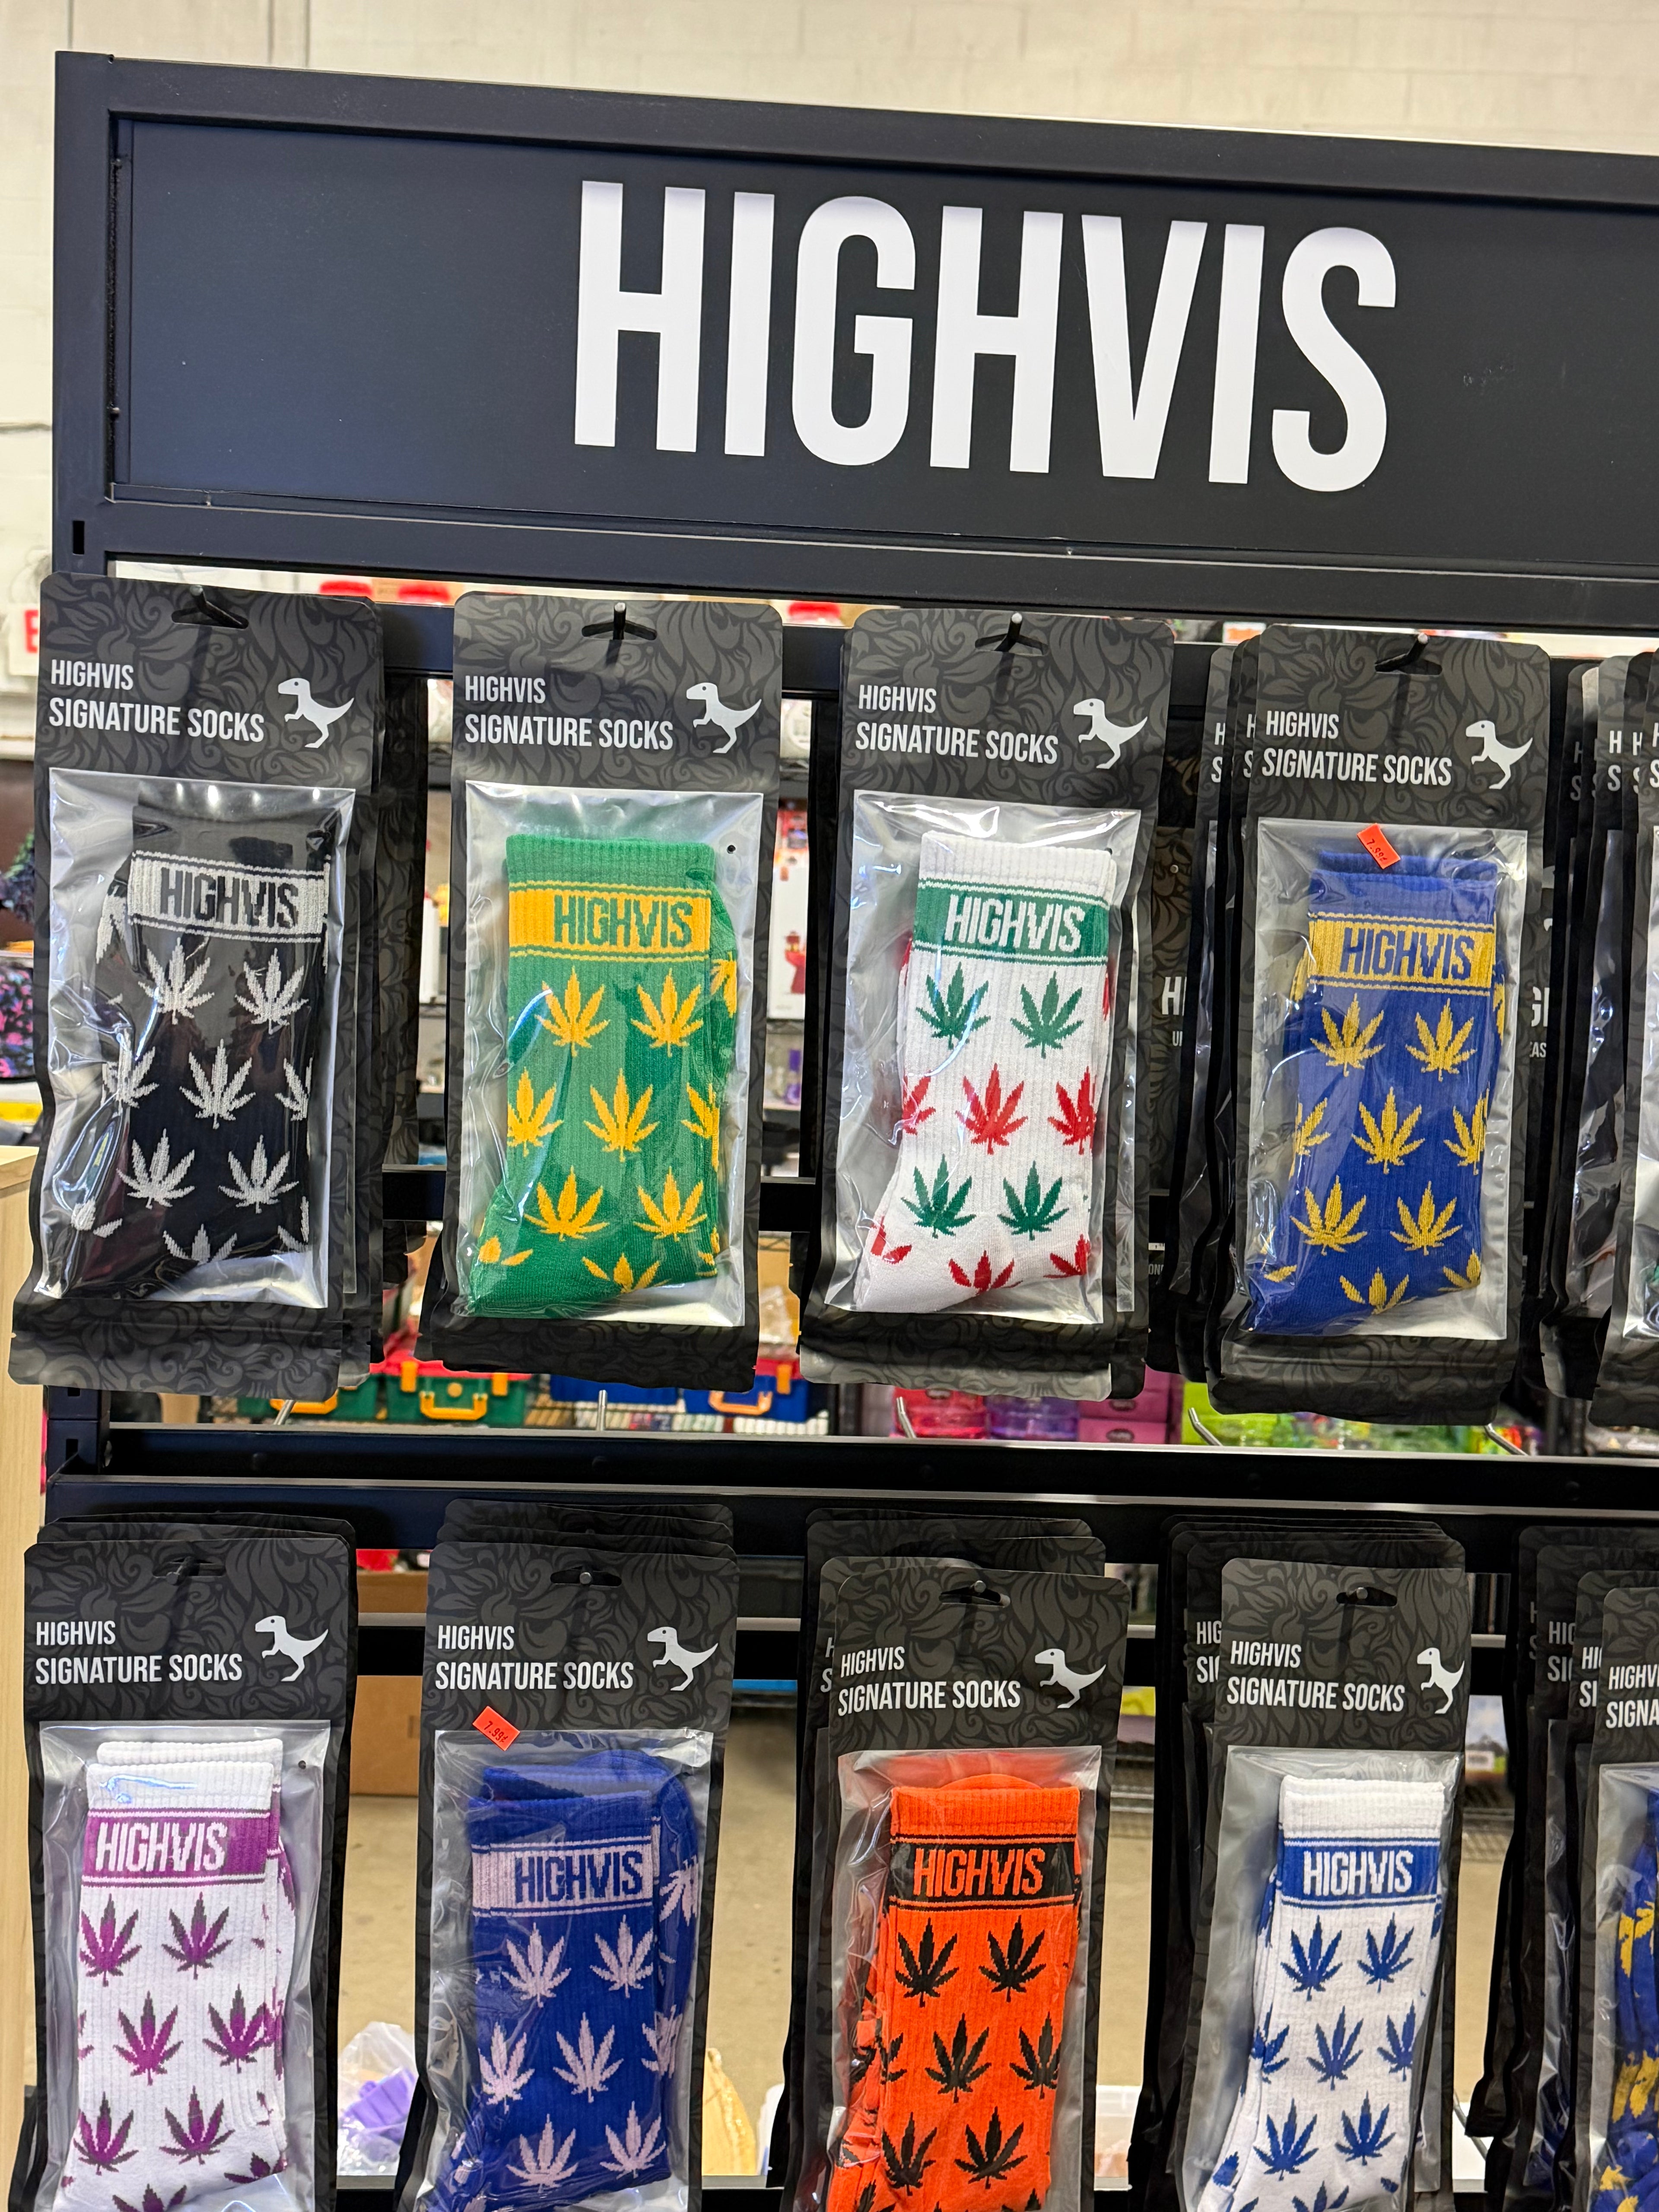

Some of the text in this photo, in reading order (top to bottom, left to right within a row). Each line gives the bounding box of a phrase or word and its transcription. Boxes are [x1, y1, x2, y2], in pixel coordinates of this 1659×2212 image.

[575, 181, 1395, 491] HIGHVIS
[51, 660, 133, 690] HIGHVIS
[466, 676, 545, 703] HIGHVIS
[859, 685, 936, 713] HIGHVIS
[49, 698, 264, 742] SIGNATURE SOCKS
[466, 714, 673, 750] SIGNATURE SOCKS
[1266, 711, 1338, 739] HIGHVIS
[856, 722, 1058, 764] SIGNATURE SOCKS
[1262, 748, 1378, 782] SIGNATURE
[1383, 755, 1452, 785] SOCKS
[160, 867, 299, 928] HIGHVIS
[554, 894, 694, 949] HIGHVIS
[944, 894, 1086, 953] HIGHVIS
[1340, 927, 1475, 979] HIGHVIS
[37, 1621, 115, 1645] HIGHVIS
[438, 1625, 514, 1649] HIGHVIS
[36, 1654, 242, 1684] SIGNATURE SOCKS
[841, 1646, 905, 1678] HIGHVIS
[1231, 1641, 1301, 1668] HIGHVIS
[435, 1662, 633, 1690] SIGNATURE SOCKS
[1227, 1677, 1405, 1711] SIGNATURE SOCKS
[838, 1681, 1020, 1716] SIGNATURE SOCKS
[95, 1822, 228, 1872] HIGHVIS
[515, 1850, 644, 1903] HIGHVIS
[913, 1848, 1046, 1897] HIGHVIS
[1303, 1850, 1413, 1897] HIGHVIS
